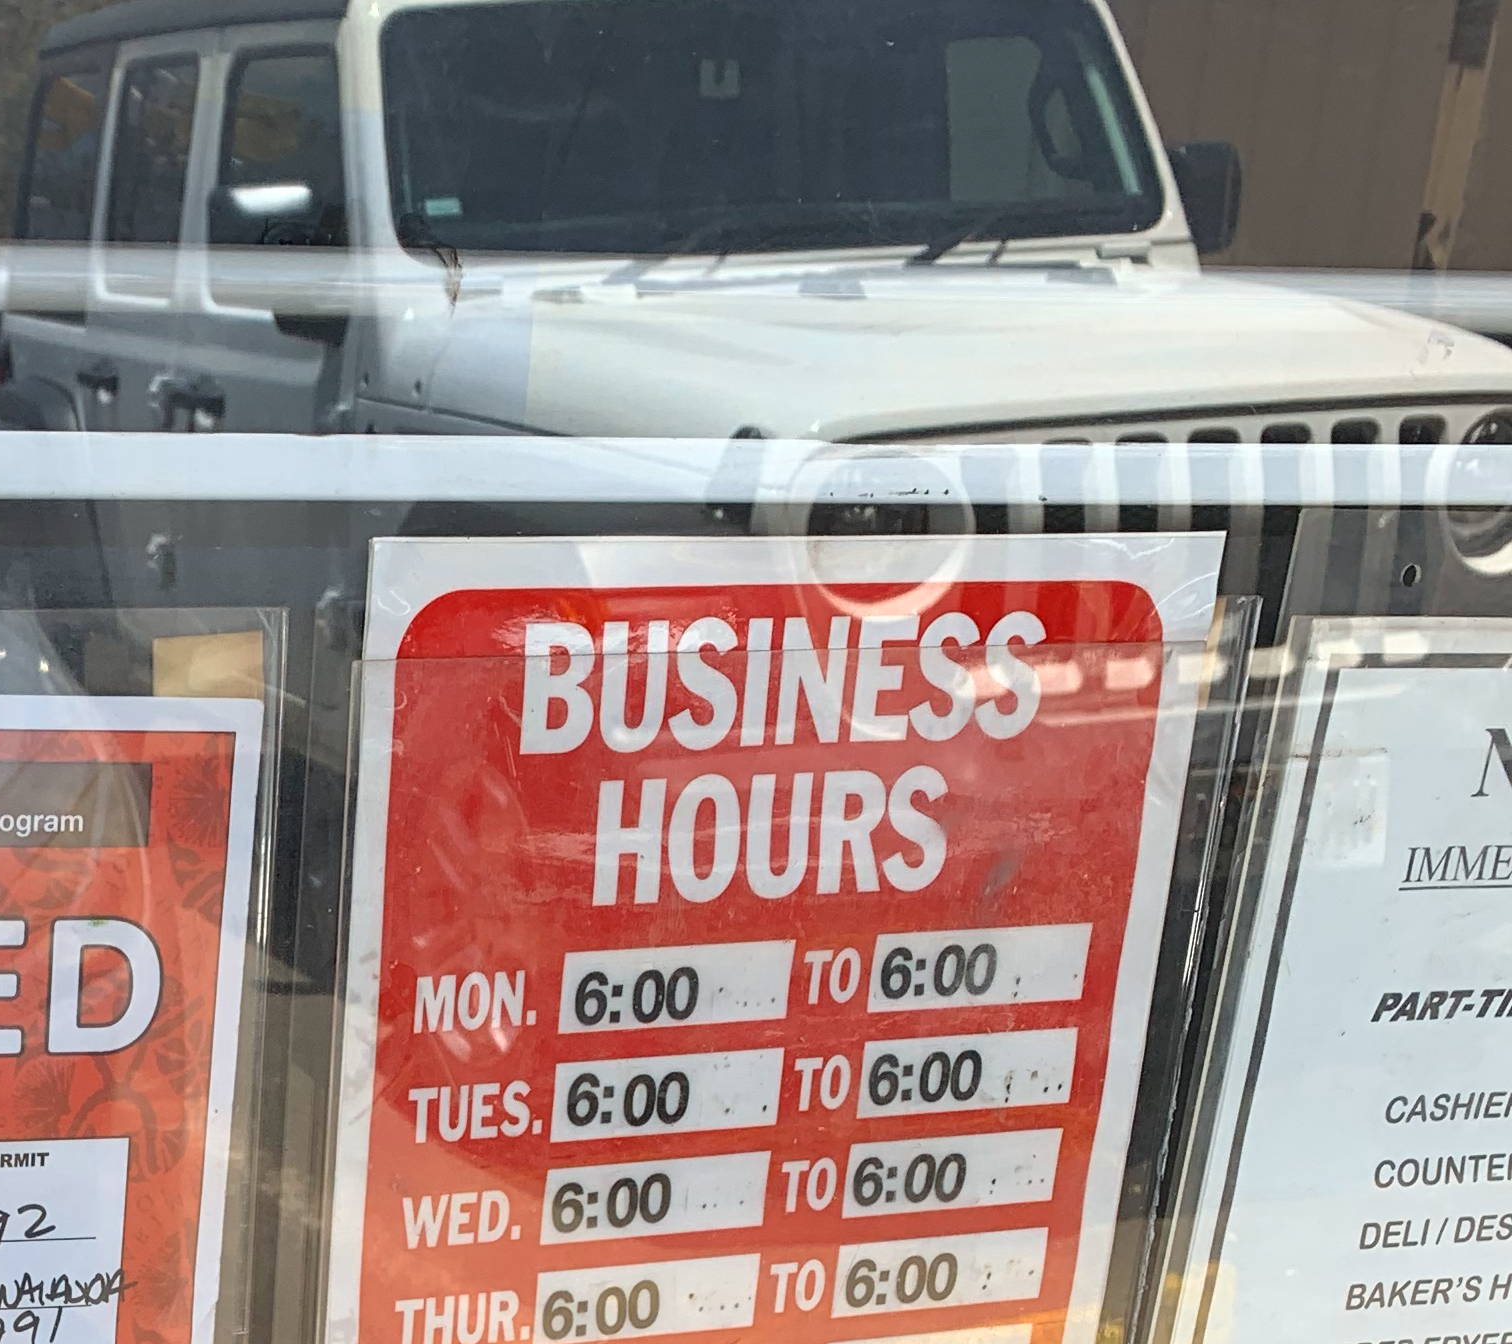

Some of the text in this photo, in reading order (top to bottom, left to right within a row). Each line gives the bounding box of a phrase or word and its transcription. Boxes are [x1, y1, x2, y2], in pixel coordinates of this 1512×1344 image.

[518, 611, 1048, 757] BUSINESS
[592, 765, 949, 908] HOURS
[413, 943, 998, 1036] MON. 6:00 TO 6:00
[408, 1049, 983, 1145] TUES. 6:00 TO 6:00
[402, 1152, 968, 1250] WED. 6:00 TO 6:00
[1374, 1153, 1512, 1188] COUNTE
[1359, 1219, 1430, 1249] DELI
[541, 1279, 660, 1340] 6:00
[771, 1260, 825, 1312] TO
[845, 1252, 958, 1307] 6:00
